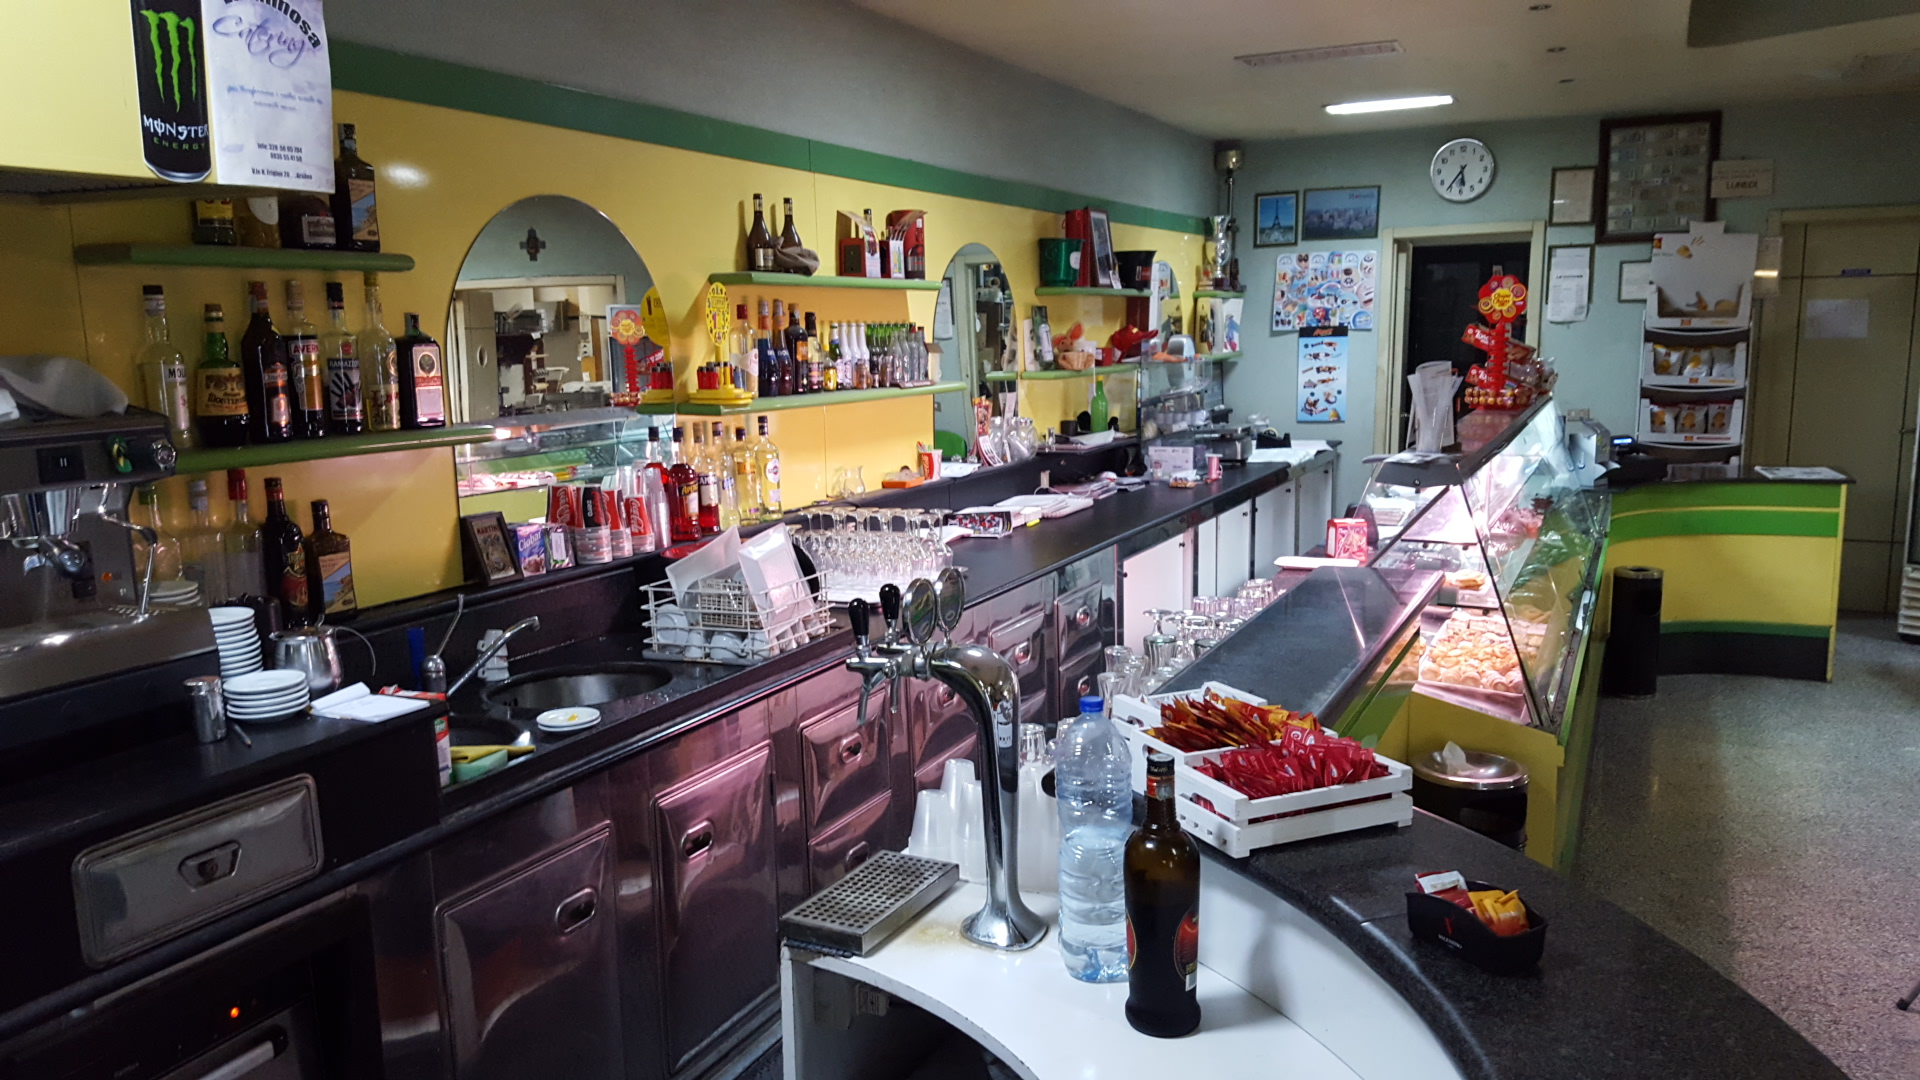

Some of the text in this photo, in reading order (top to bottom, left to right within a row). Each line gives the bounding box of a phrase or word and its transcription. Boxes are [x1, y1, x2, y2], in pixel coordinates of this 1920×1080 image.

[142, 113, 209, 141] MONSTER
[153, 136, 206, 151] ENERGY
[518, 531, 542, 551] Ciobar
